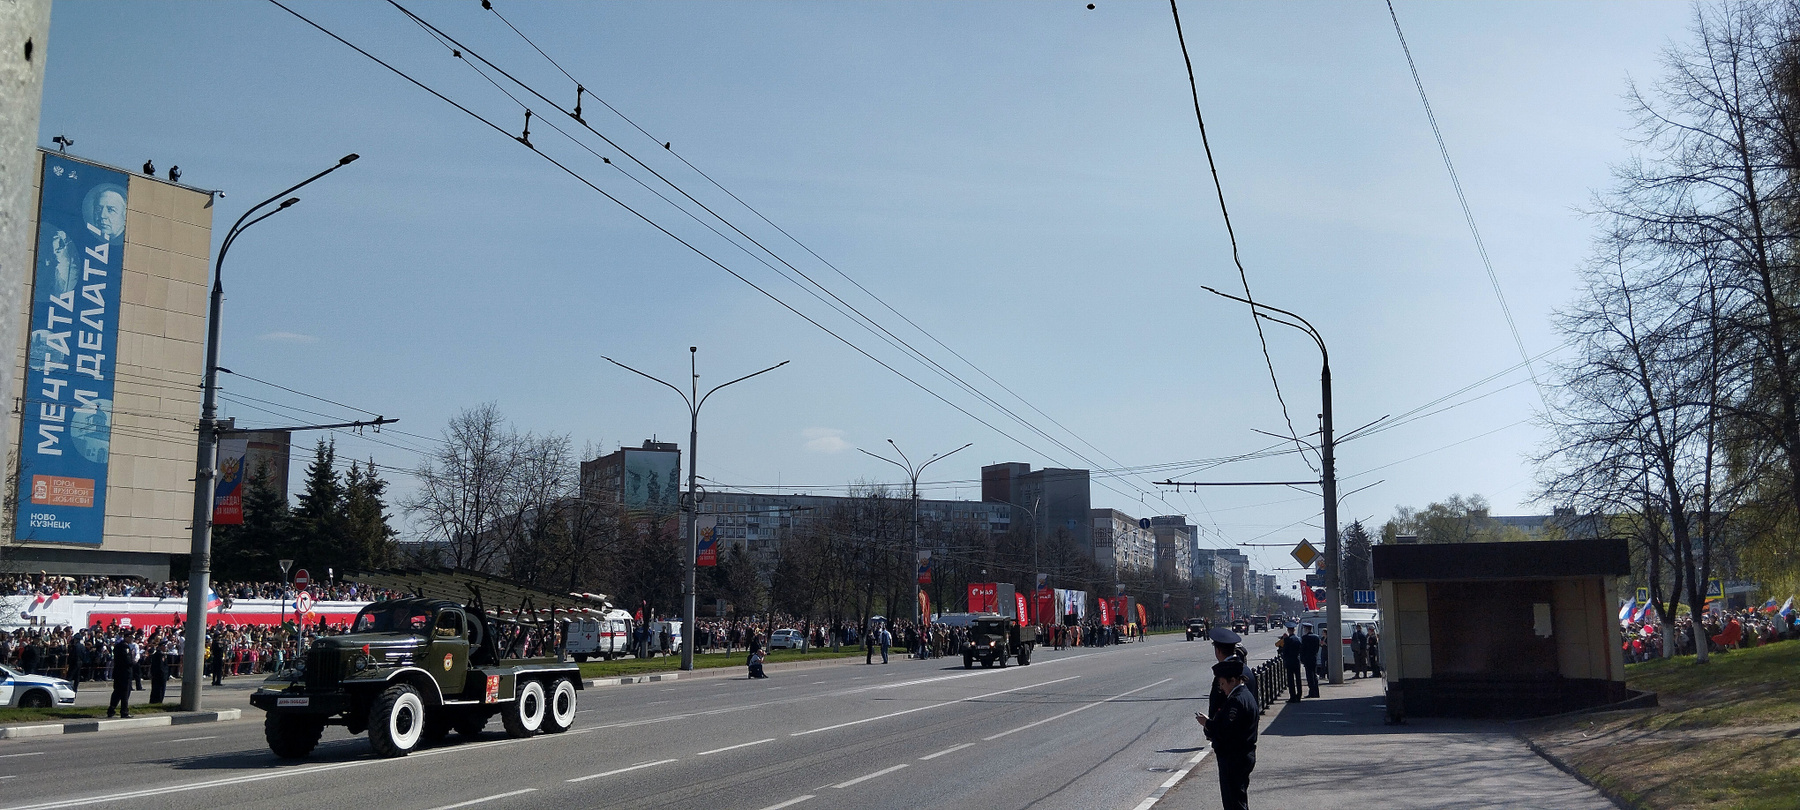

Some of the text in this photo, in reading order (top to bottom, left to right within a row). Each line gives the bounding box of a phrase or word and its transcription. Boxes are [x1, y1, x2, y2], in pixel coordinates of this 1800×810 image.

[76, 222, 110, 380] ДЕЛАТЬ!
[37, 290, 75, 456] МЕЧТАТЬ
[30, 513, 56, 521] НОВО
[30, 520, 71, 530] КУЗНЕЦК
